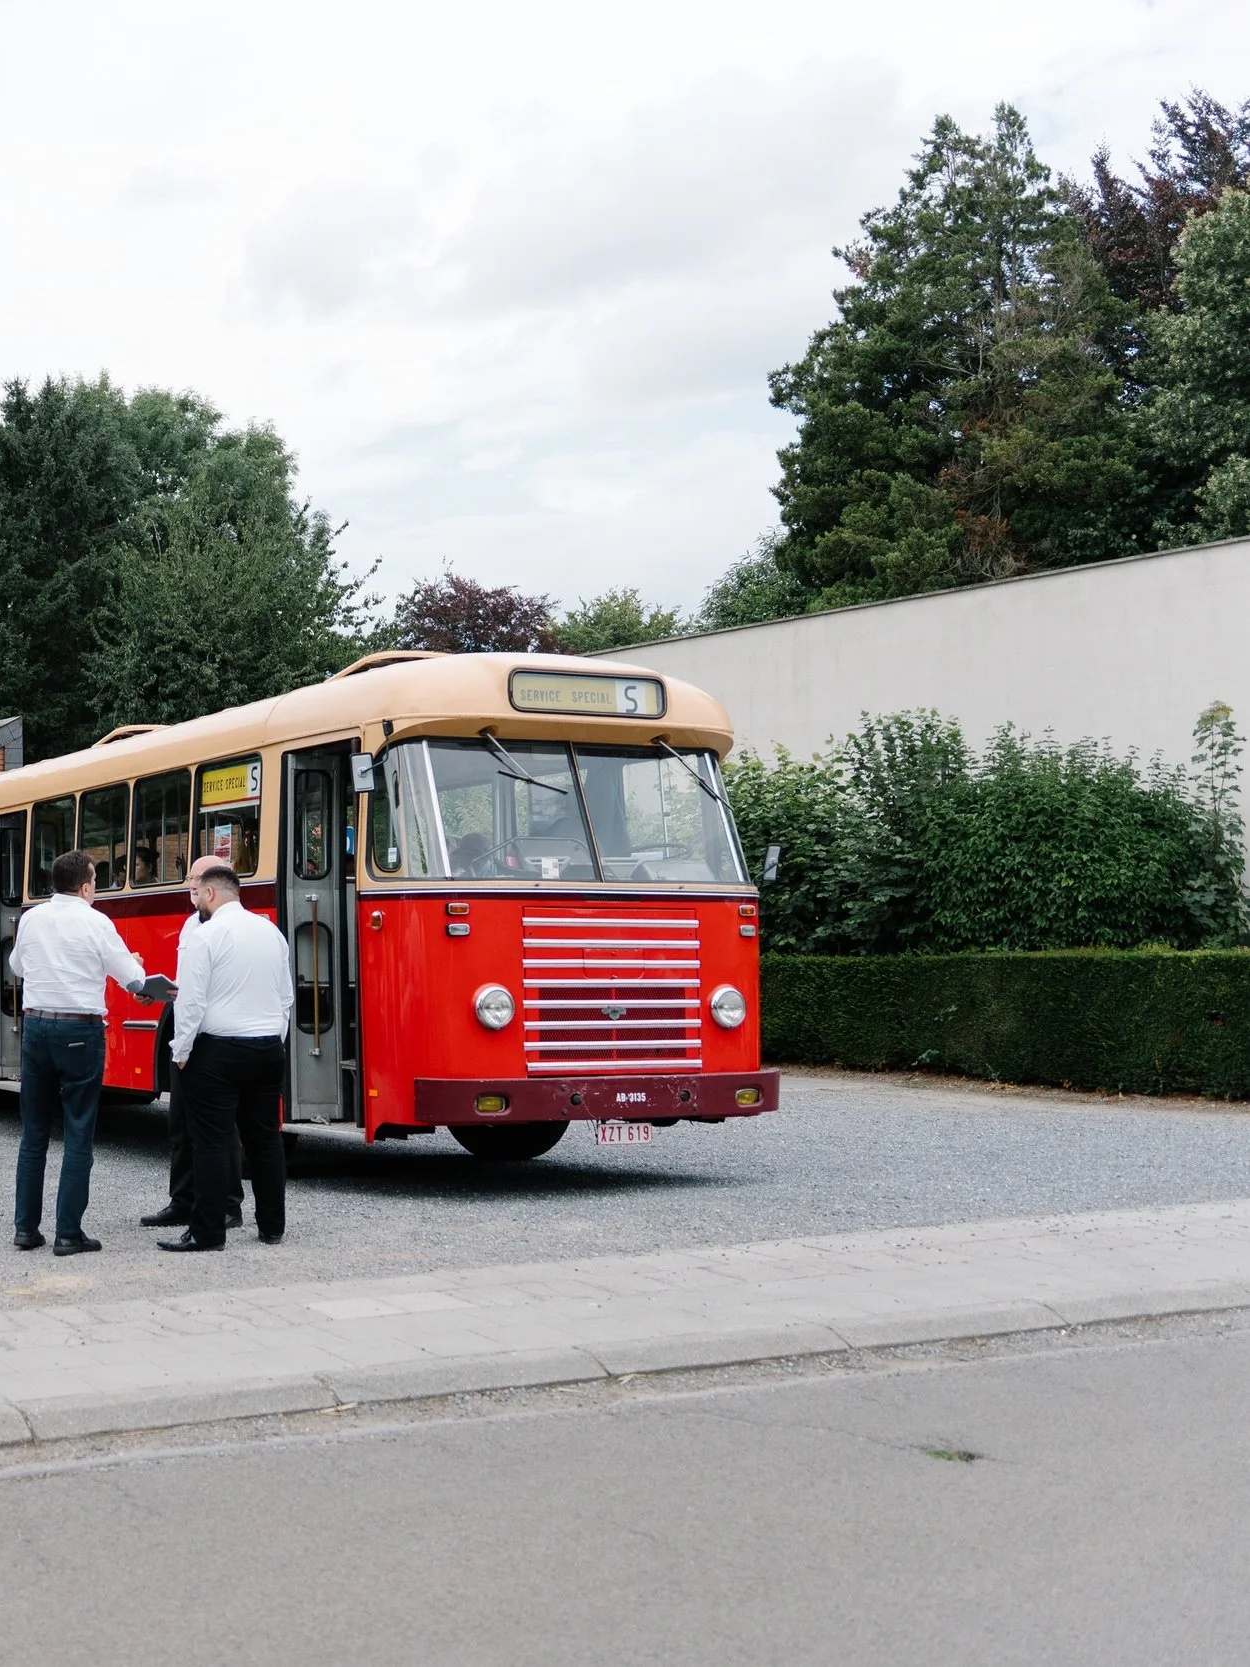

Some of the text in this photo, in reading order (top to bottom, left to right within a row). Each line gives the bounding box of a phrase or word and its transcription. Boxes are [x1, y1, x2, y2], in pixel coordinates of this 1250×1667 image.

[519, 685, 639, 714] SERVICE SPECIAL S
[203, 775, 246, 793] SERVICE SPECIAL
[251, 765, 258, 792] S
[600, 1125, 649, 1142] XZT 619
